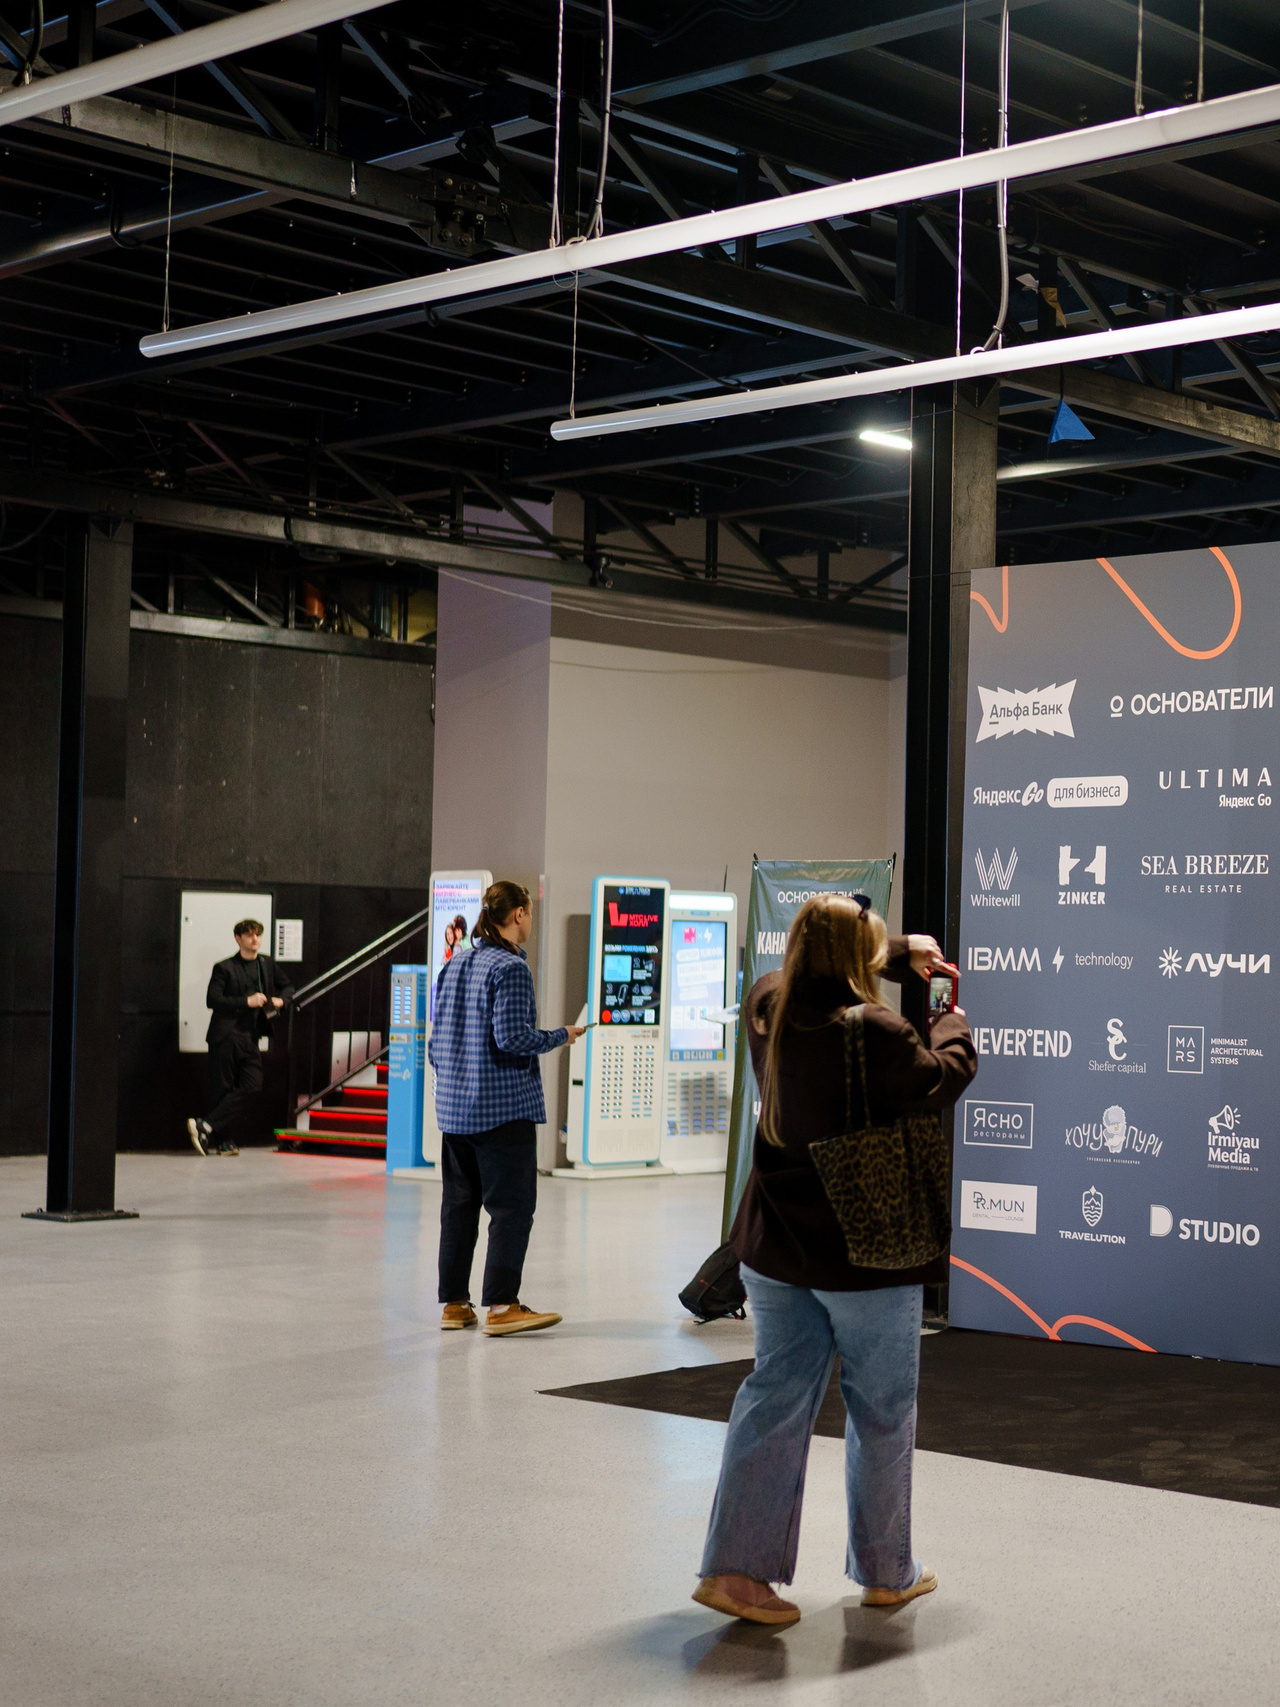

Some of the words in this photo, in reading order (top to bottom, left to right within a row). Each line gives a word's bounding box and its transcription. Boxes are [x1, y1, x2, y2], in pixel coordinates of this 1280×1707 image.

[1131, 687, 1273, 715] ОСНОВАТЕЛИ
[990, 703, 1029, 720] Альфа
[1033, 702, 1062, 715] Банк
[1160, 768, 1271, 789] ULTIMA
[974, 787, 1021, 806] Яндекс
[1022, 782, 1044, 806] Go
[1054, 788, 1074, 801] для
[1076, 783, 1120, 798] бизнеса
[1219, 795, 1254, 808] Яндекс
[1258, 794, 1271, 806] Go
[1141, 856, 1178, 875] SEA
[1185, 855, 1268, 874] BREEZE
[1165, 885, 1192, 893] REAL
[1200, 885, 1241, 893] ESTATE
[971, 894, 1020, 906] Whitewill
[1058, 892, 1105, 904] ZINKER
[757, 931, 791, 955] КАНА
[968, 947, 1041, 971] IBMM
[1075, 952, 1133, 969] technology
[1210, 1038, 1248, 1046] MINIMALIST
[1210, 1048, 1263, 1056] ARCHITECTURAL
[1088, 1059, 1116, 1072] Shefer
[1117, 1061, 1147, 1073] capital
[1210, 1057, 1239, 1065] SYSTEMS
[974, 1131, 1025, 1139] рестораны
[1208, 1131, 1260, 1150] Irmiyau
[1208, 1147, 1250, 1164] Media
[1059, 1231, 1125, 1244] TRAVELUTION
[1179, 1219, 1260, 1246] STUDIO
